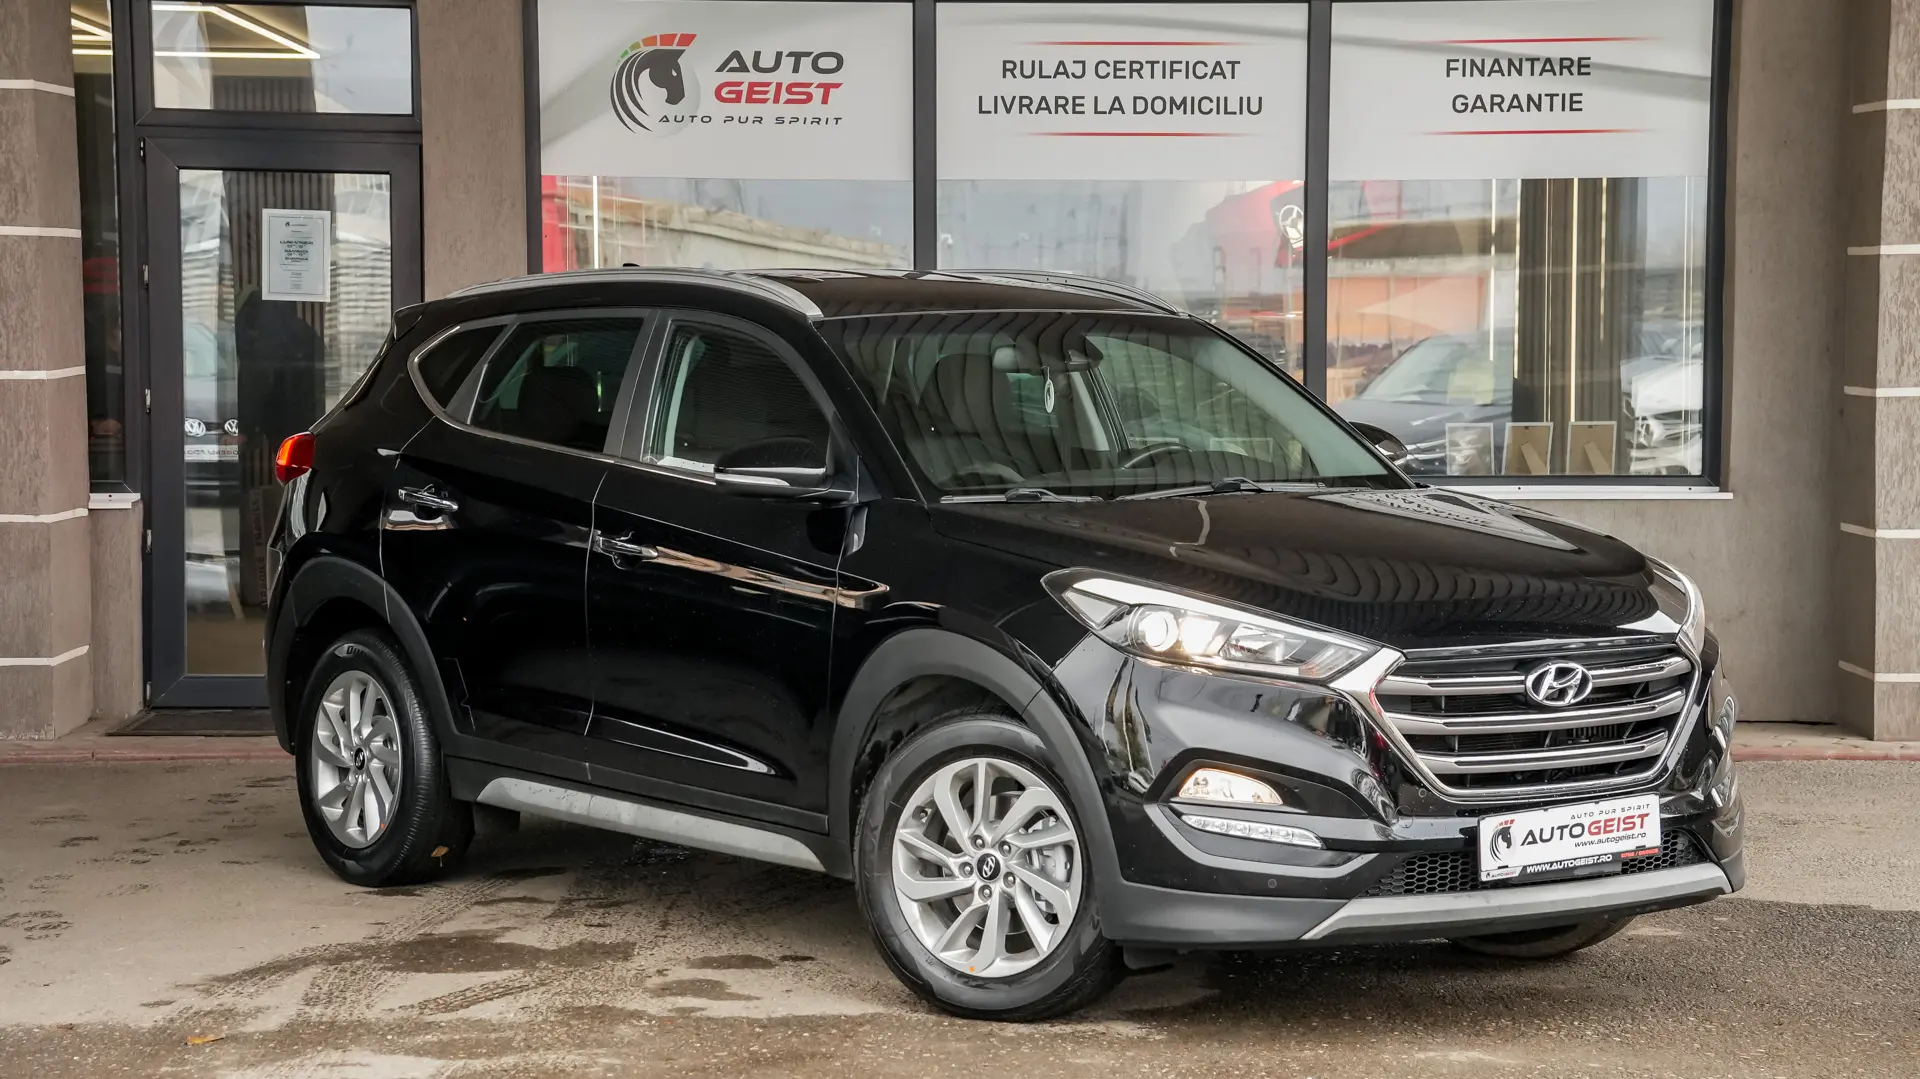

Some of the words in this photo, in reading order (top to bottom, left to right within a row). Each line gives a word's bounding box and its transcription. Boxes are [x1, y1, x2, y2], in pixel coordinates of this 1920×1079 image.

[714, 49, 844, 75] AUTO
[1001, 59, 1087, 80] RULAJ
[1094, 59, 1241, 80] CERTIFICAT
[1446, 56, 1592, 78] FINANTARE
[714, 81, 844, 105] GEIST
[1451, 92, 1585, 114] GARANTIE
[978, 95, 1086, 115] LIVRARE
[1093, 95, 1126, 115] LA
[1132, 95, 1264, 116] DOMICILIU
[658, 114, 713, 124] AUTO
[723, 115, 764, 125] PUR
[774, 116, 843, 126] SPIRIT
[1570, 810, 1595, 820] AUTO
[1598, 808, 1617, 816] PUR
[1620, 803, 1651, 813] SPIRIT
[1574, 832, 1647, 848] www.autogeist.ro
[1526, 854, 1613, 874] WWW.AUTOGEIST.RO
